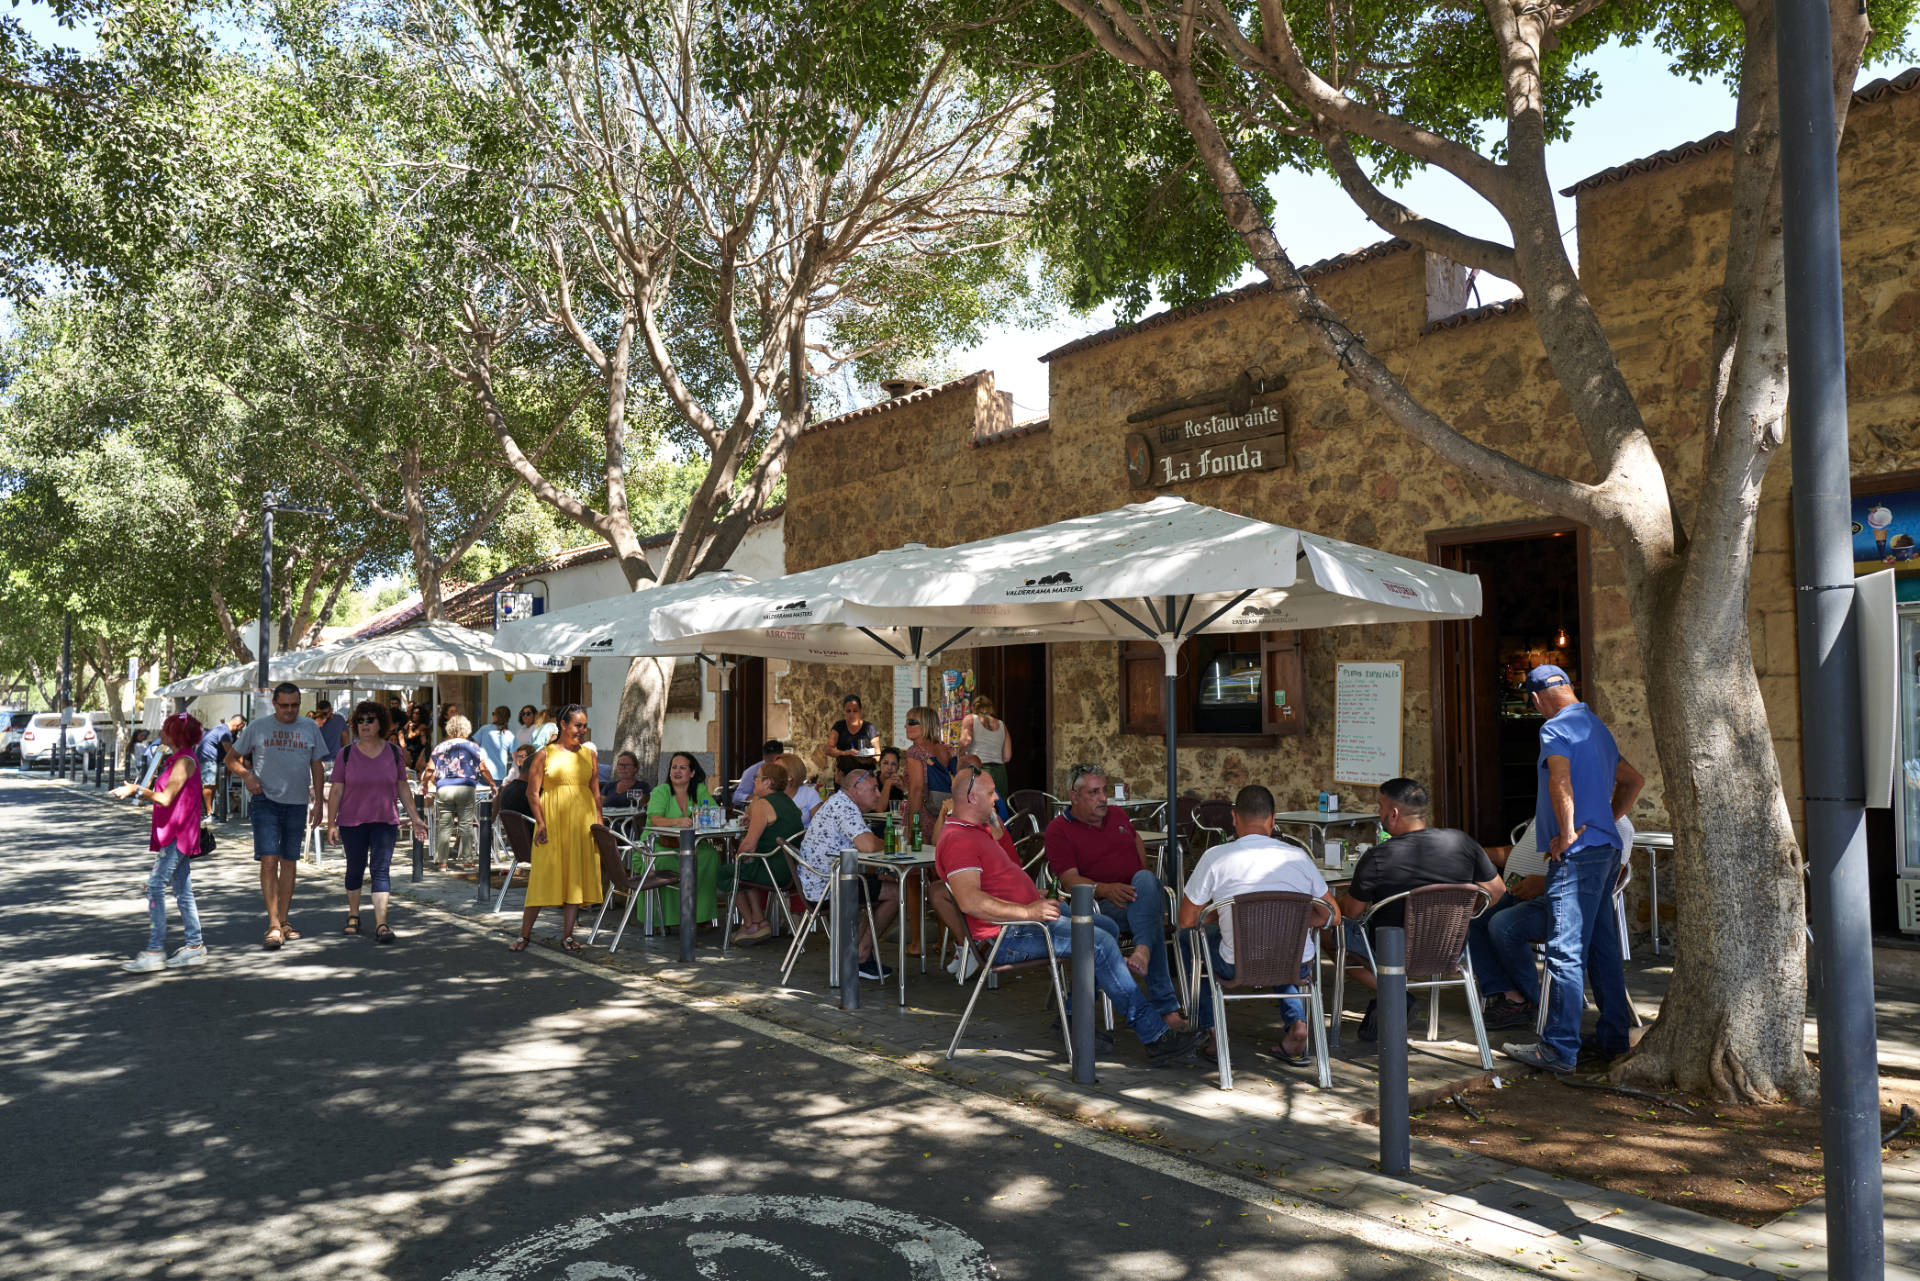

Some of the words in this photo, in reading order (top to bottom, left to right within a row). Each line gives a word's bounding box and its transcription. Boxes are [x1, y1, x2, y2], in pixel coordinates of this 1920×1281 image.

[1184, 406, 1280, 439] Restaurante
[1159, 455, 1192, 484] La
[1006, 587, 1051, 596] VALDERRAMA
[1051, 586, 1084, 594] MASTERS
[272, 730, 301, 740] SOUTH
[263, 737, 309, 750] HAMPTONS
